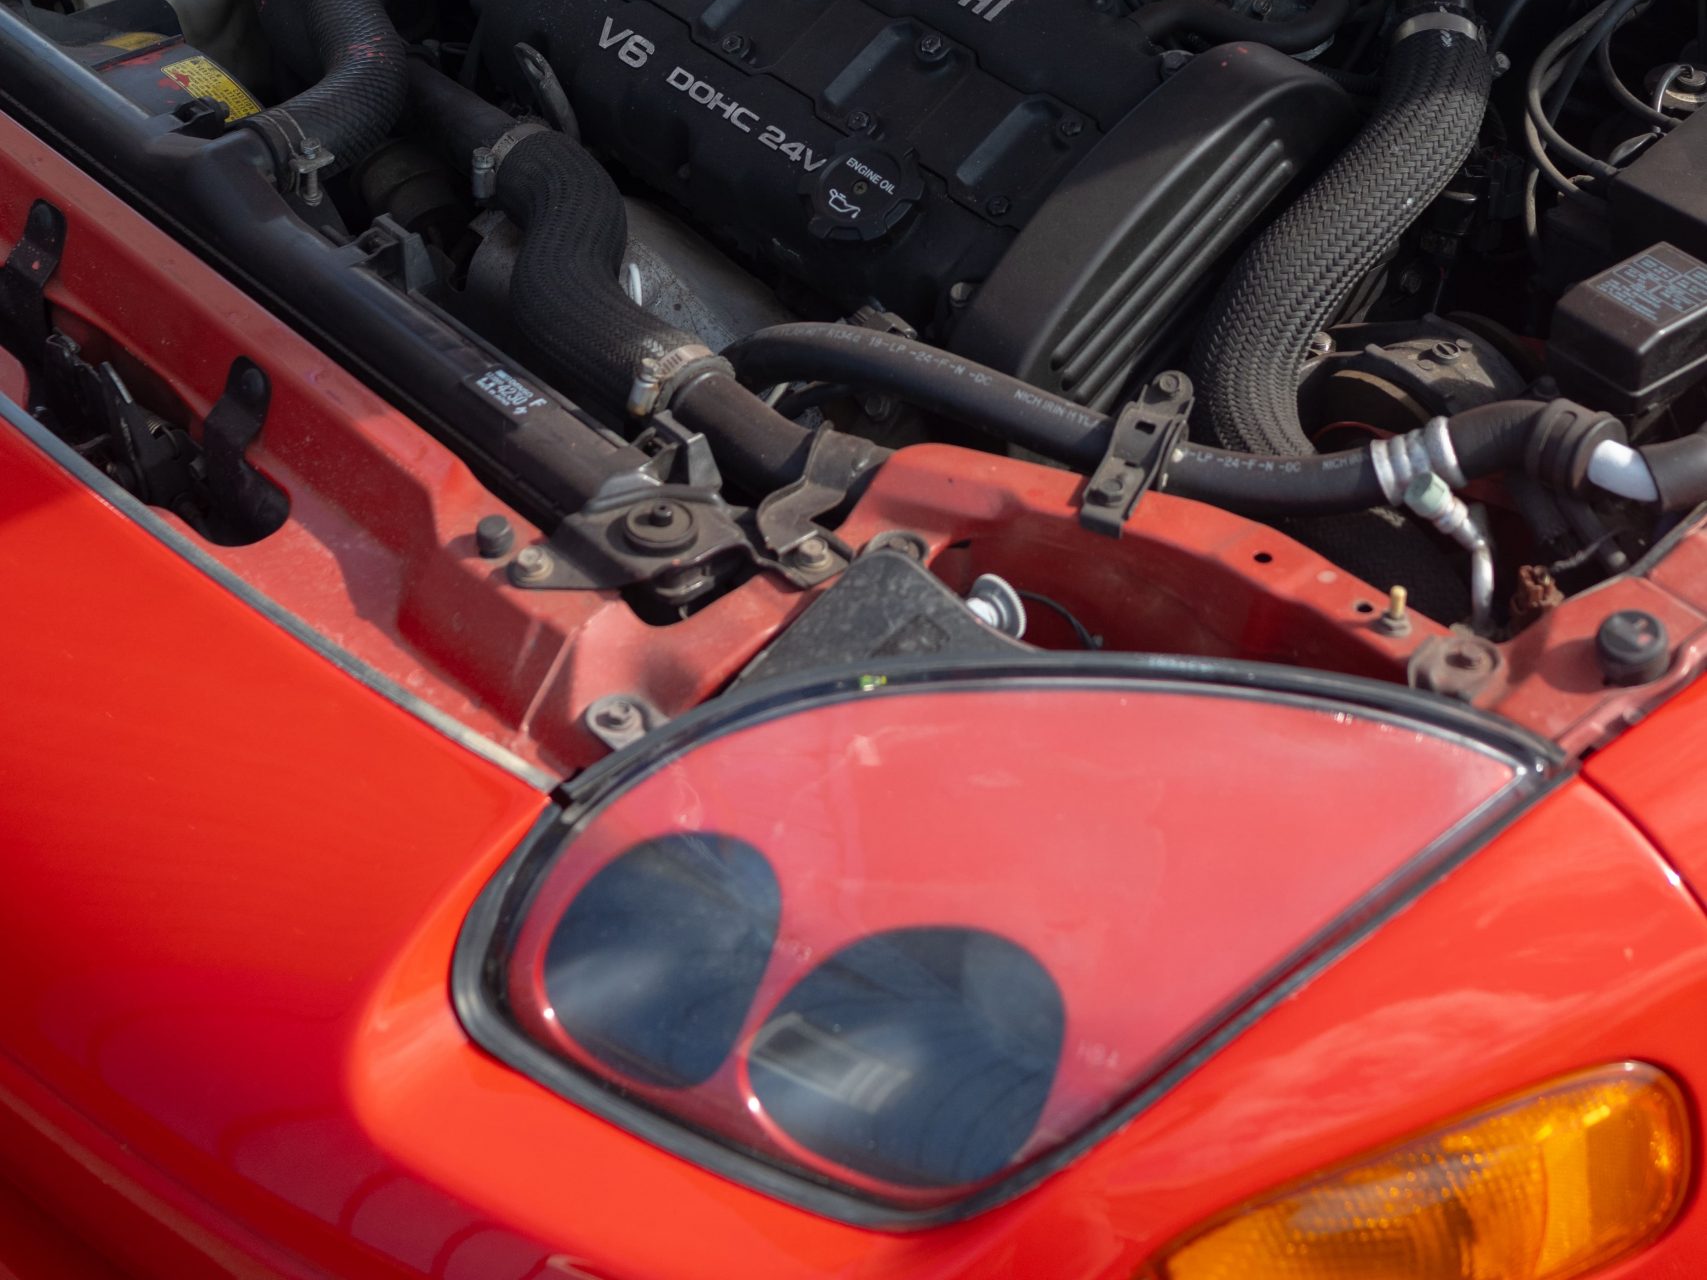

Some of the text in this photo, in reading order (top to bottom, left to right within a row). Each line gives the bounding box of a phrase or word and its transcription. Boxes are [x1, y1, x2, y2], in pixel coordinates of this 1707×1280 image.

[598, 16, 655, 68] V6
[666, 66, 828, 172] DOHC 24V
[846, 157, 898, 195] ENGINE OIL
